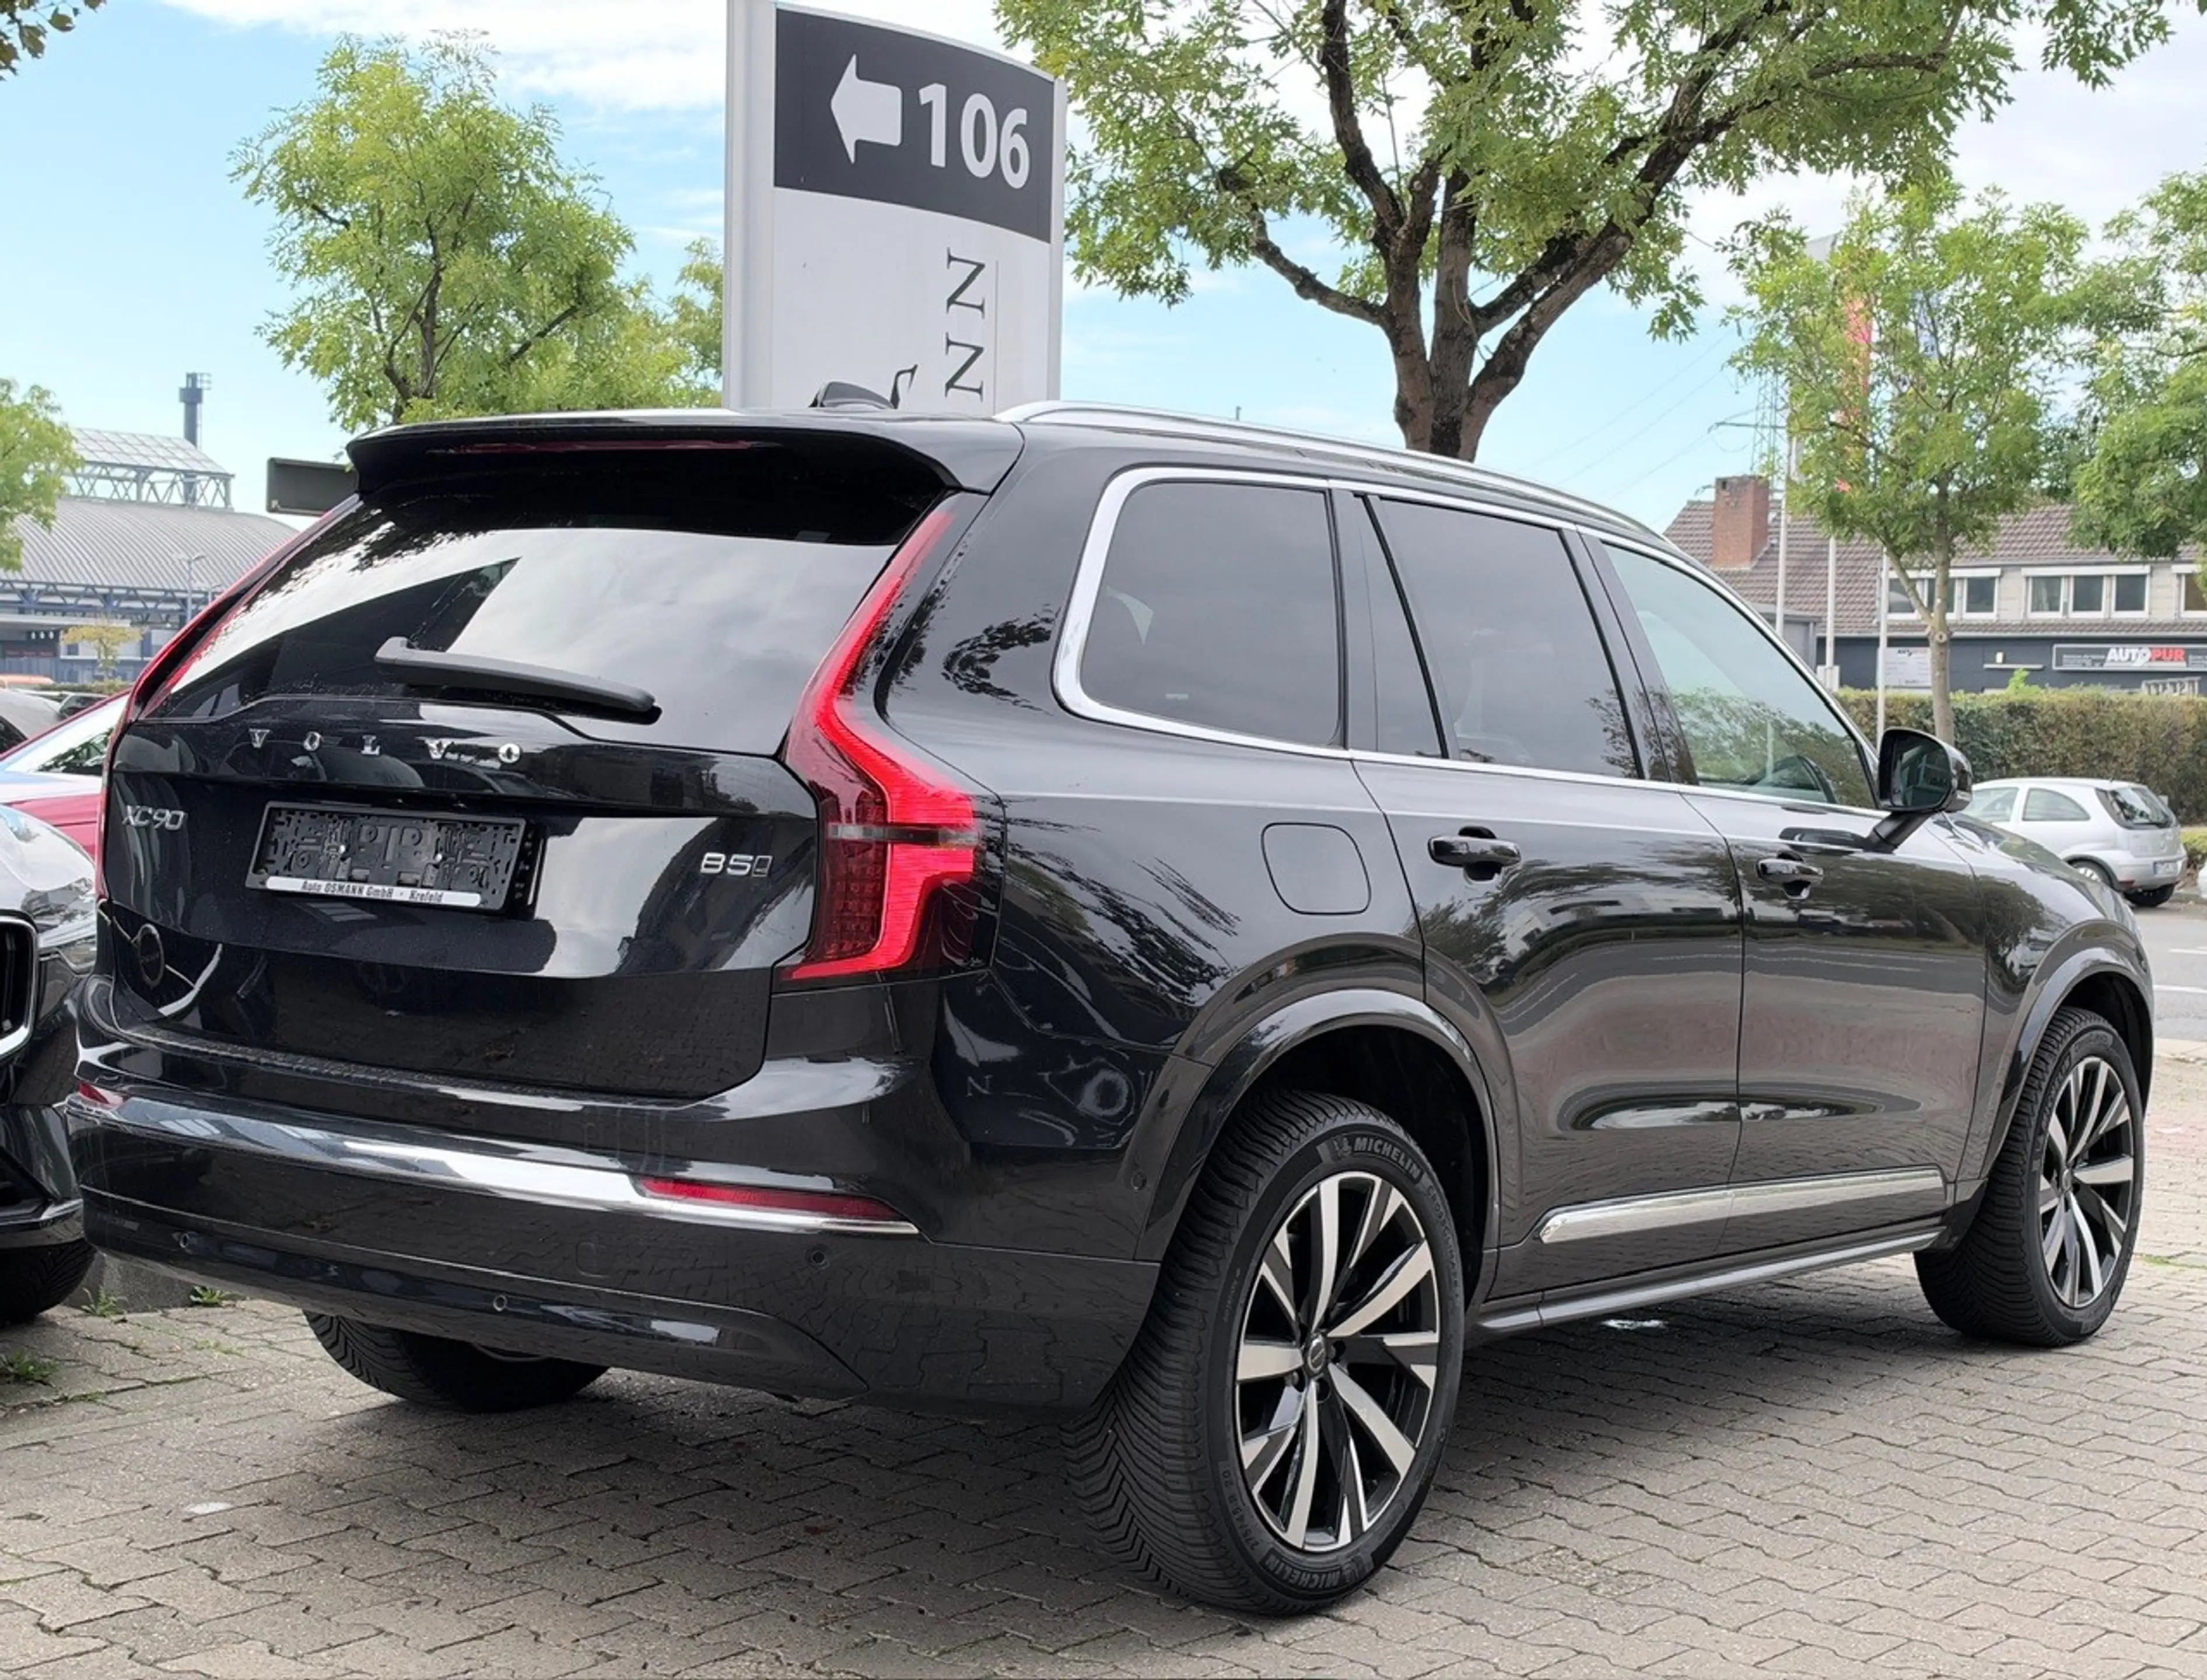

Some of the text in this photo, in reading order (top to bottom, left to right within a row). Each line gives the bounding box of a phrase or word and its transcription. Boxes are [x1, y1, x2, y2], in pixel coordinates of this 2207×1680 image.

[917, 82, 1031, 190] 106
[248, 728, 523, 764] VOLVO
[122, 805, 185, 830] XC90
[300, 880, 323, 894] Auto
[324, 883, 364, 897] OSMANN
[365, 886, 393, 899] GmbH
[409, 890, 443, 903] Krefeld
[1354, 1138, 1421, 1180] MICHELIN
[1265, 1553, 1341, 1588] MICHELIN
